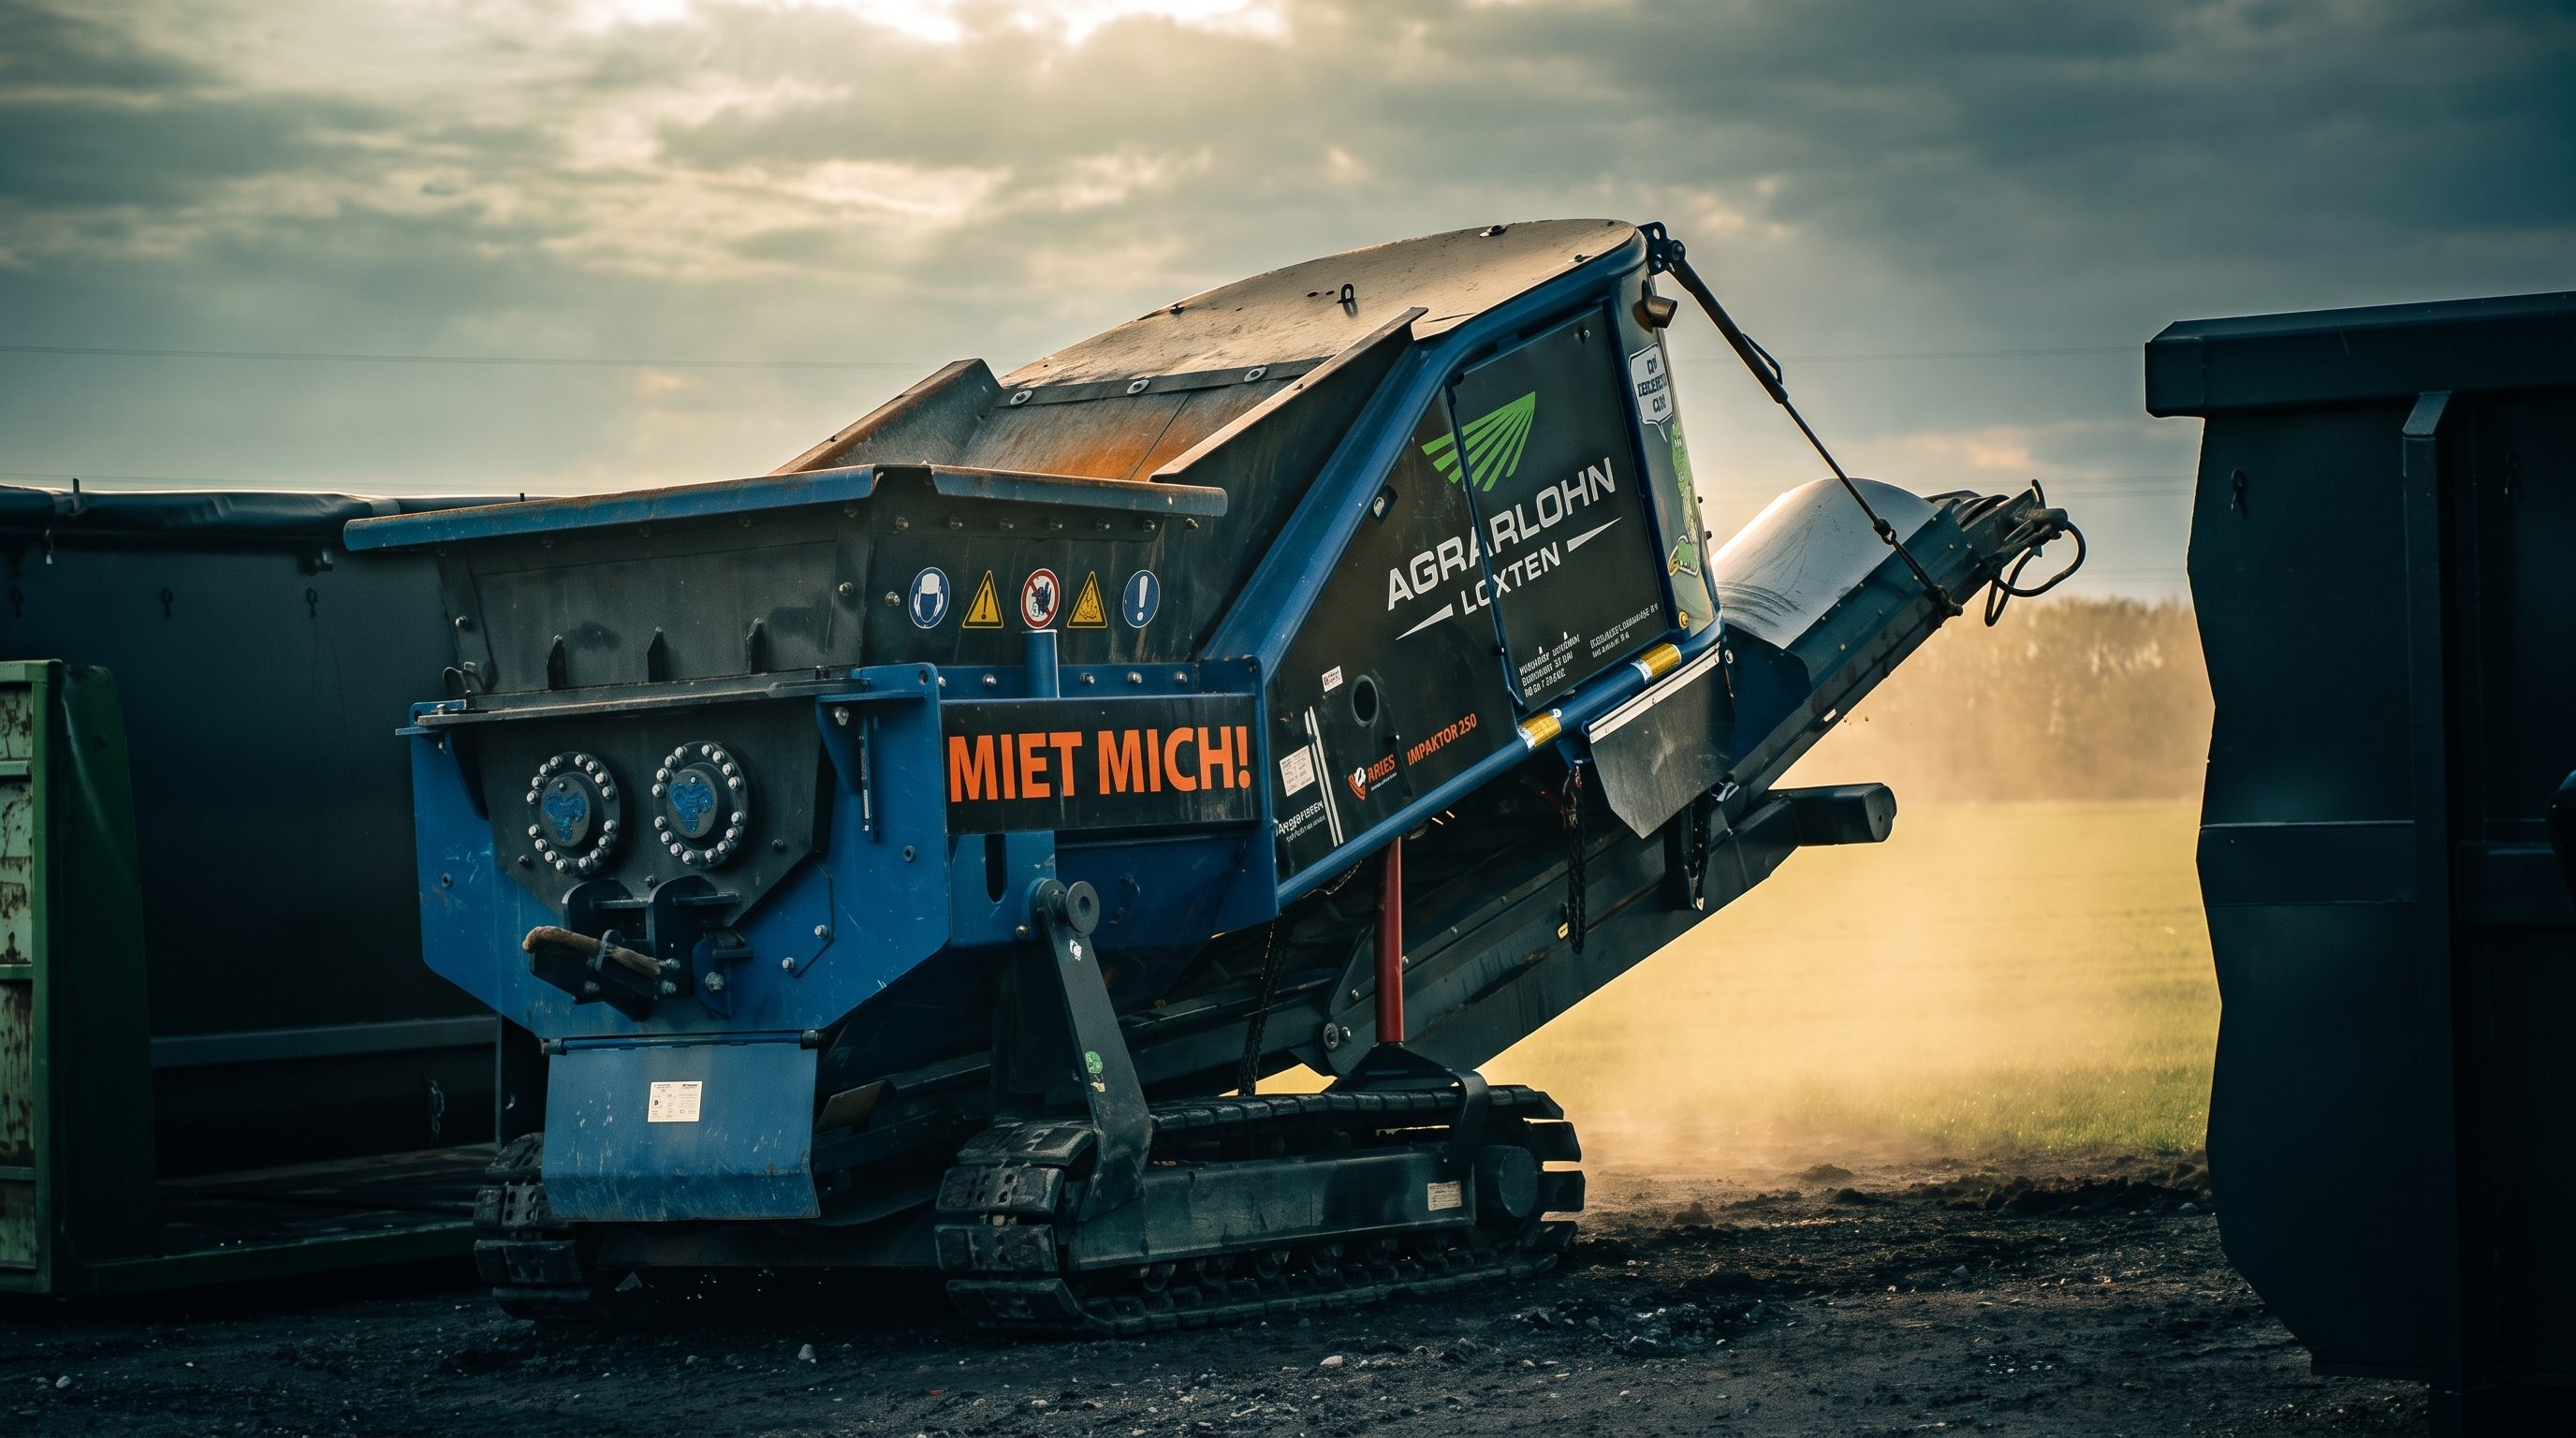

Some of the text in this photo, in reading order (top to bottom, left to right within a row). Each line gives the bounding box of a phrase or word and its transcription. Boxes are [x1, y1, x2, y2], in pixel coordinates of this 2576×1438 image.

[1387, 457, 1616, 611] AGRARLOHN
[1460, 541, 1561, 616] LOXTEN
[948, 730, 1083, 803] MIET
[1097, 726, 1251, 795] MICH!
[1367, 754, 1396, 783] ARIES
[1407, 712, 1477, 766] IMPAKTOR 250
